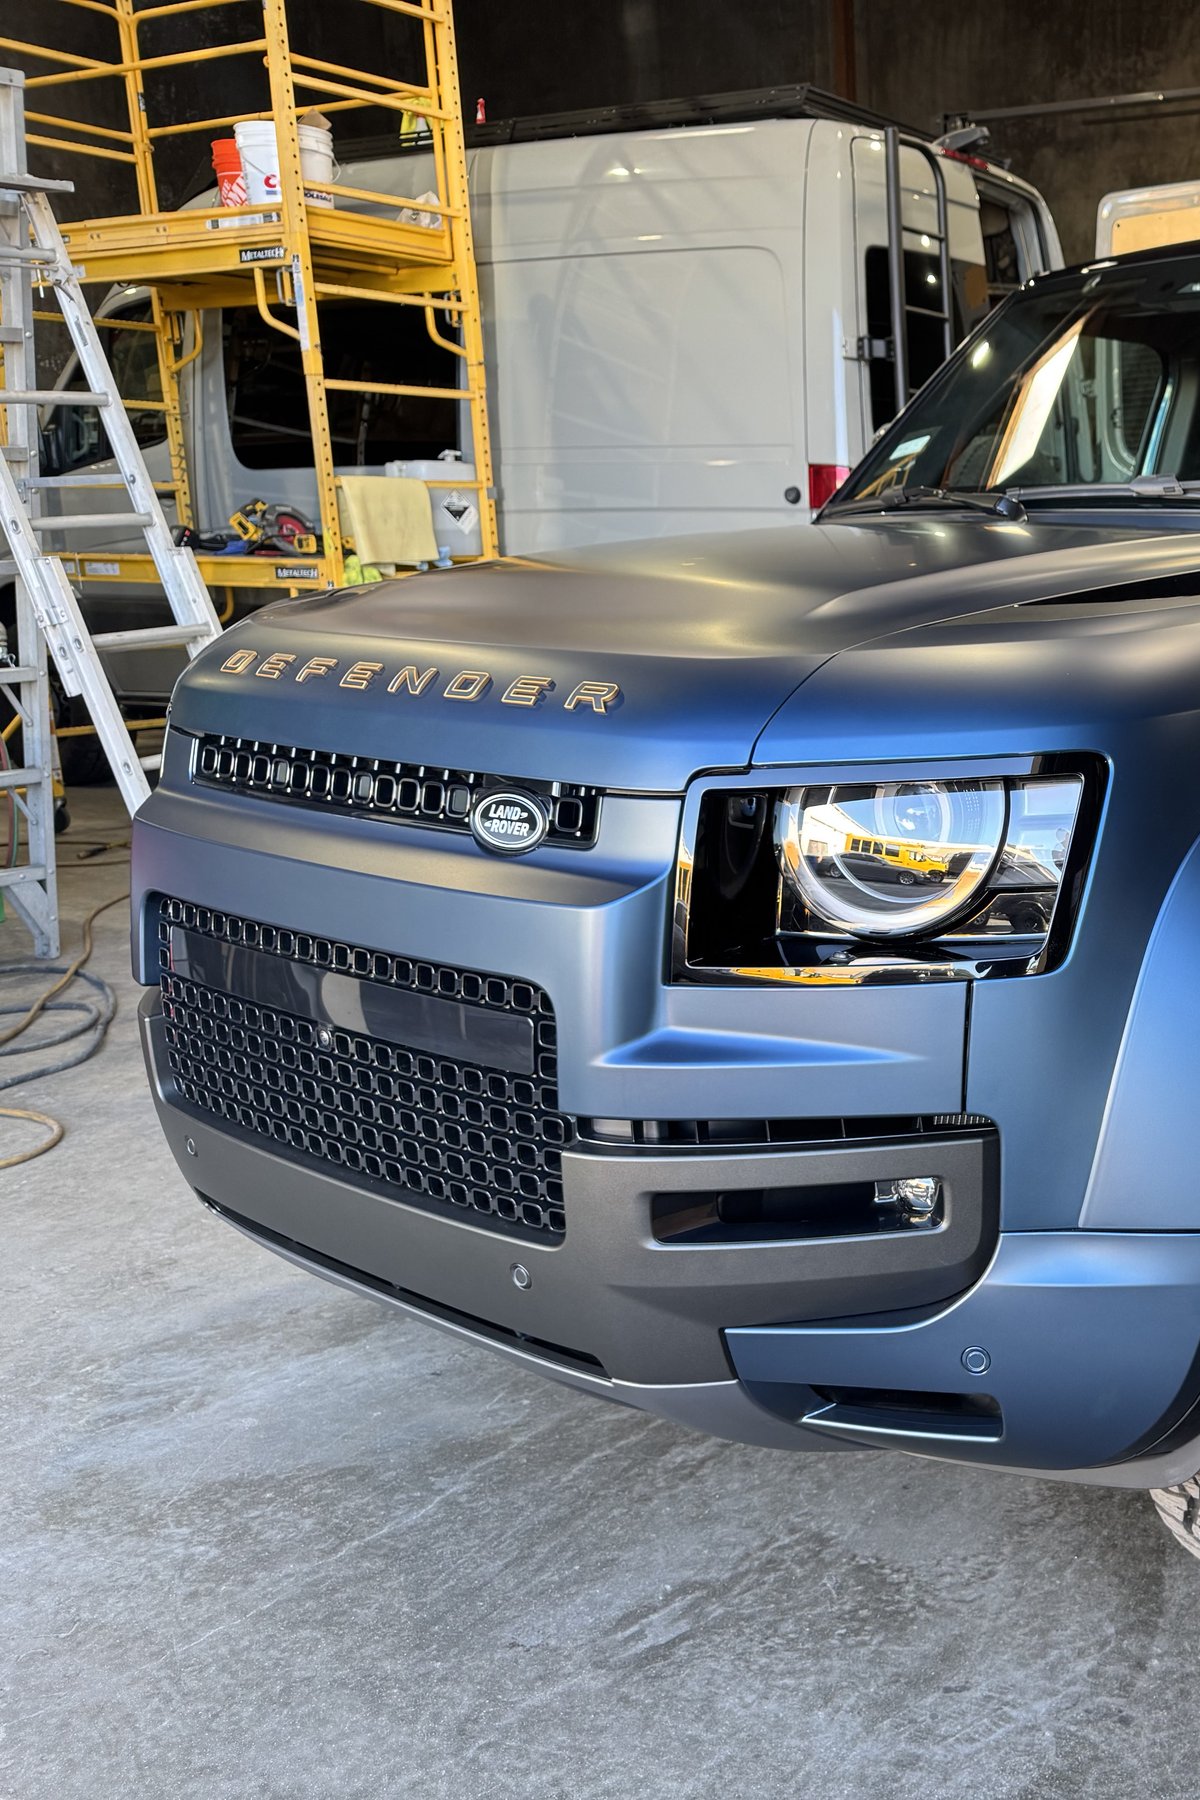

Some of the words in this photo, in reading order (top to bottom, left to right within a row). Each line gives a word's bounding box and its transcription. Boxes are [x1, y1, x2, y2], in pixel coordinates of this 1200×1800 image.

[241, 247, 285, 261] METALTECH
[277, 568, 318, 577] METALTECH
[219, 649, 623, 714] DEFENDER
[488, 804, 521, 820] LAND
[490, 819, 530, 837] ROVER
